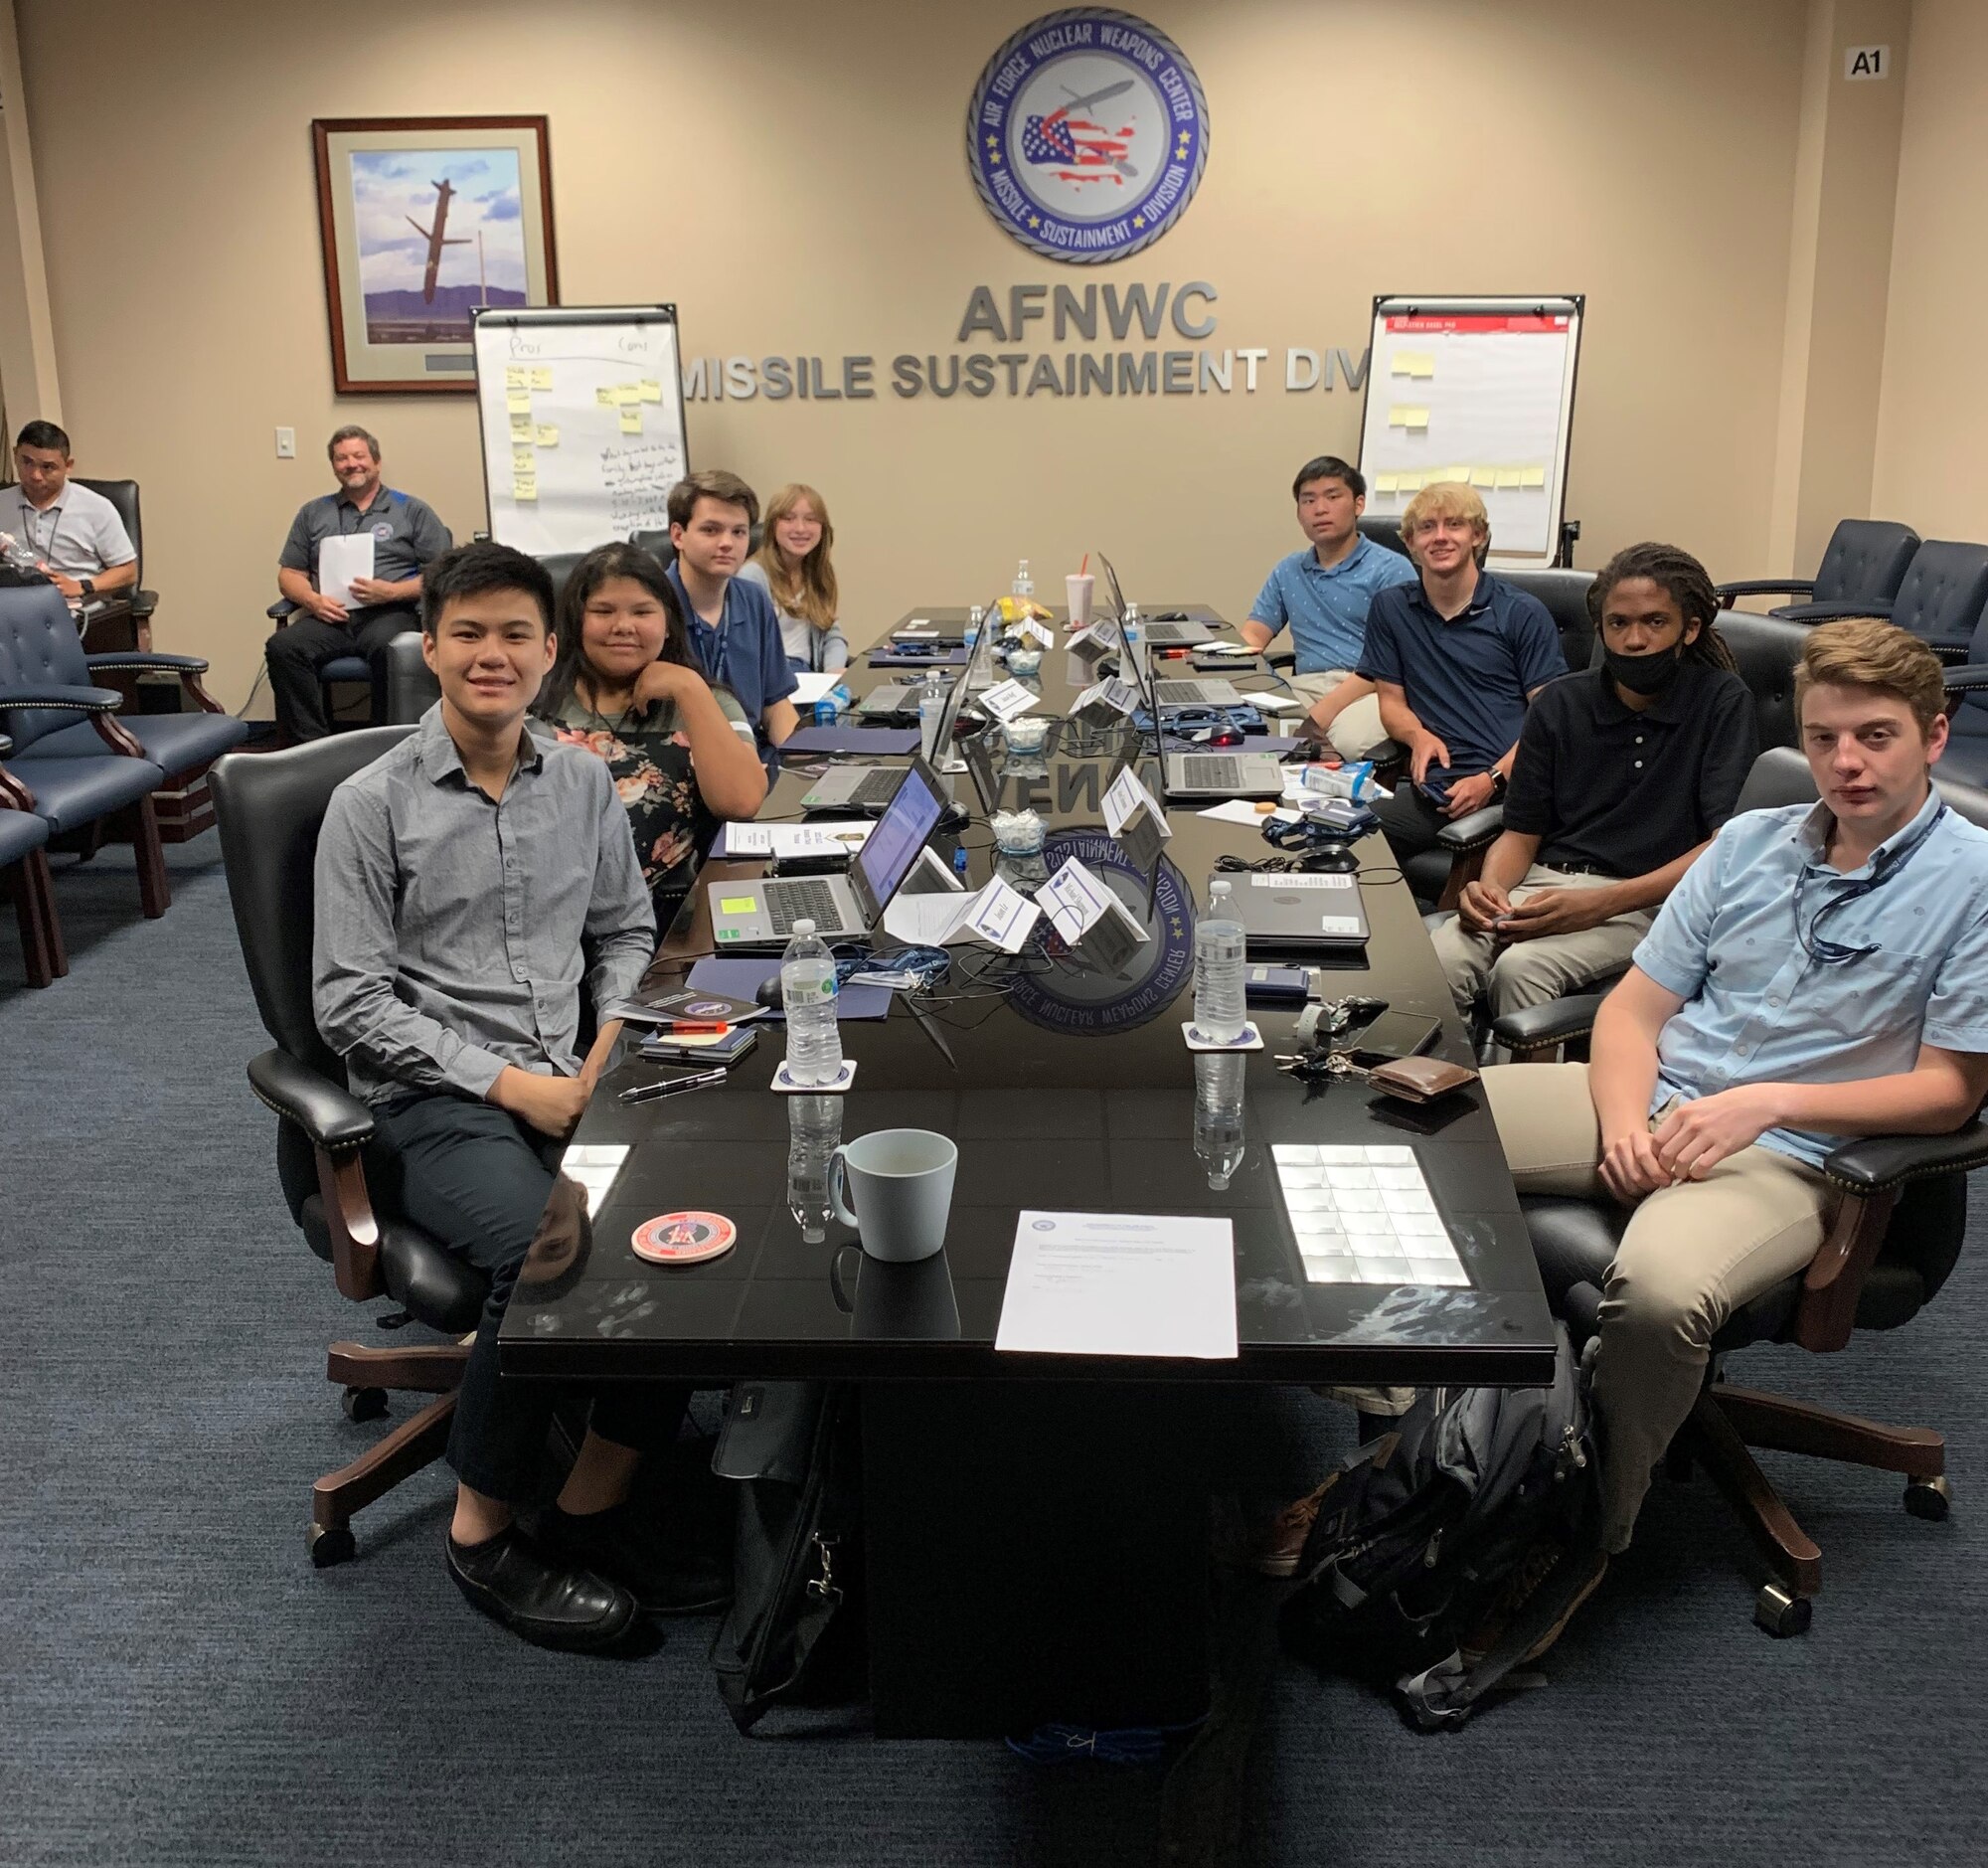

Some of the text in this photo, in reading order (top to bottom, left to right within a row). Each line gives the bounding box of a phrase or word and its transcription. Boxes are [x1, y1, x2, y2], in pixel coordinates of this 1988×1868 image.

[982, 23, 1194, 127] AIR FORCE NUCLEAR WEAPONS CENTER
[1851, 50, 1881, 75] A1
[990, 164, 1187, 249] MISSILE SUSTAINMENT DIVISION
[957, 281, 1219, 343] AFNWC
[681, 348, 1371, 402] MISSILE SUSTAINMENT DIV
